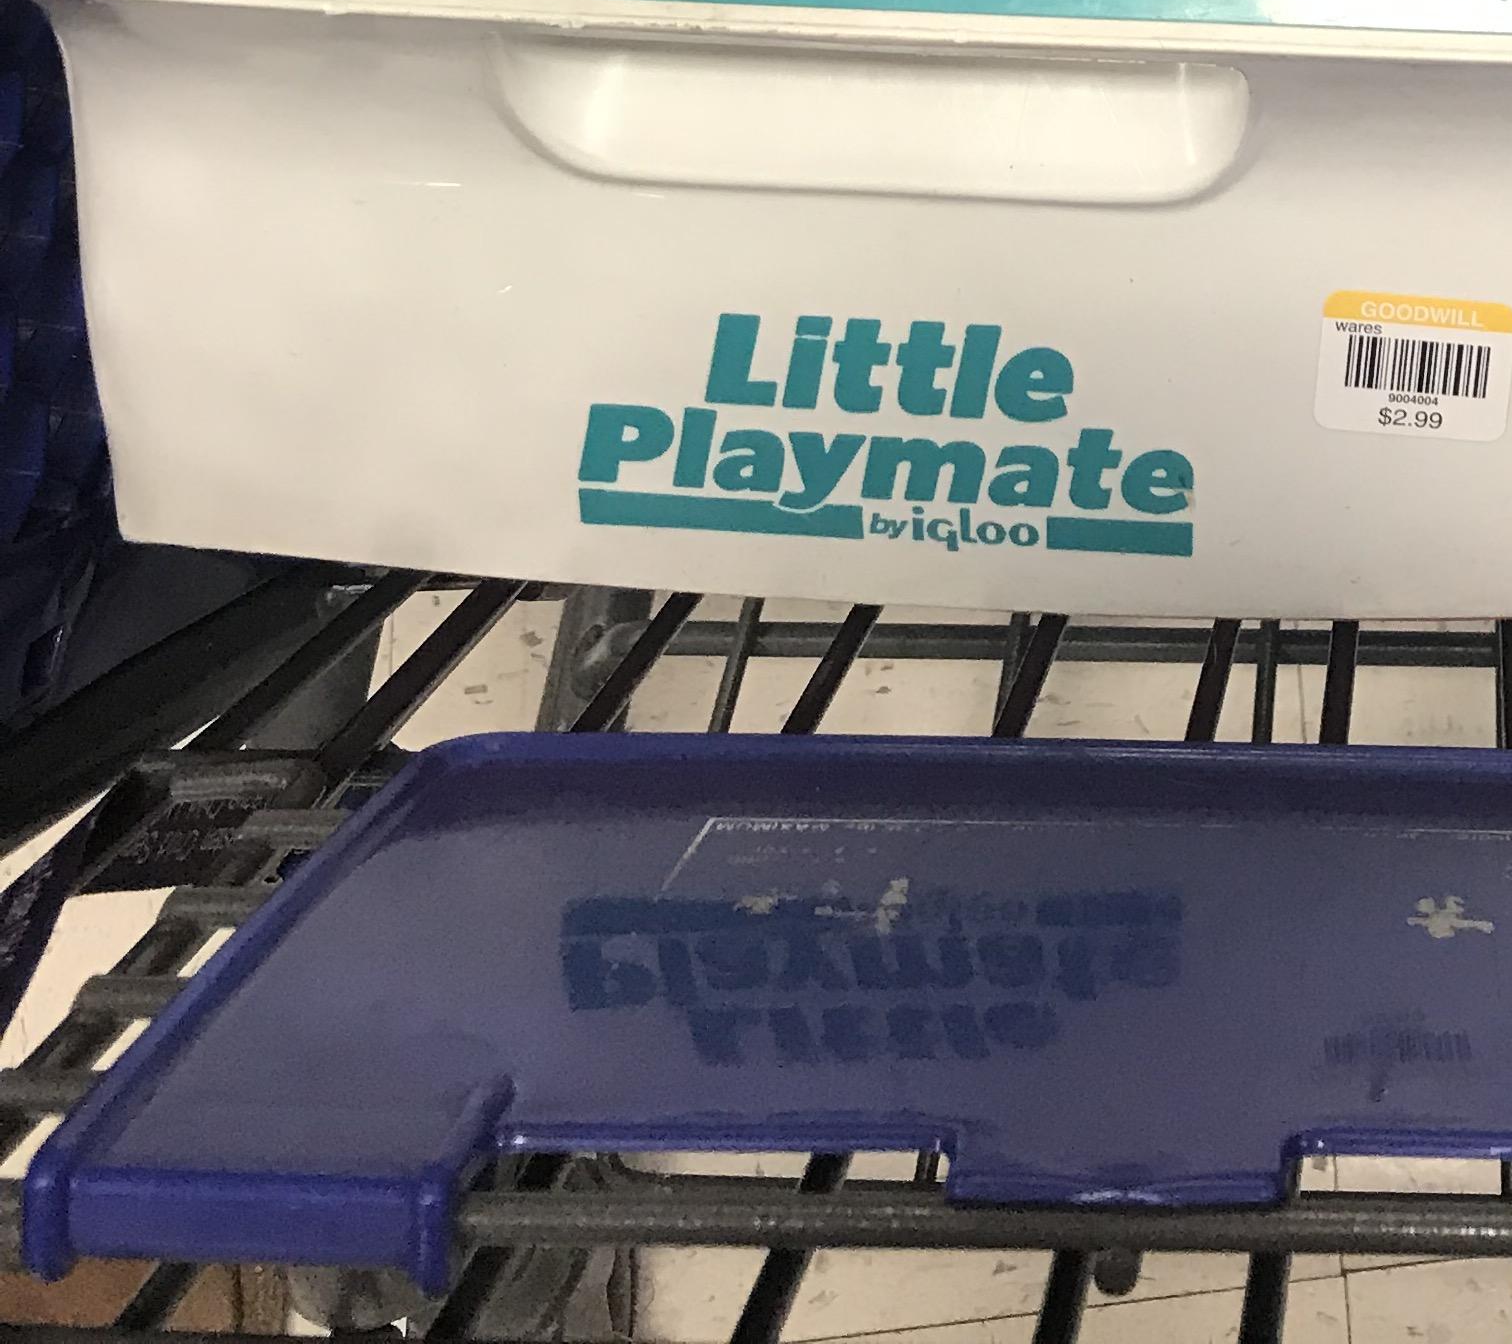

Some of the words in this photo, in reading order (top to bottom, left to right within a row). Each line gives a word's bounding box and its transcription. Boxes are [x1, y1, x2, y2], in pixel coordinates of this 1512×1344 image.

[1335, 320, 1383, 335] wares
[1360, 300, 1485, 328] GOODWILL
[704, 312, 1074, 423] Little
[1388, 393, 1439, 406] 9004004
[1377, 406, 1443, 429] $2.99
[578, 403, 1195, 514] Playmate
[870, 512, 907, 539] by
[911, 506, 1040, 552] igloo
